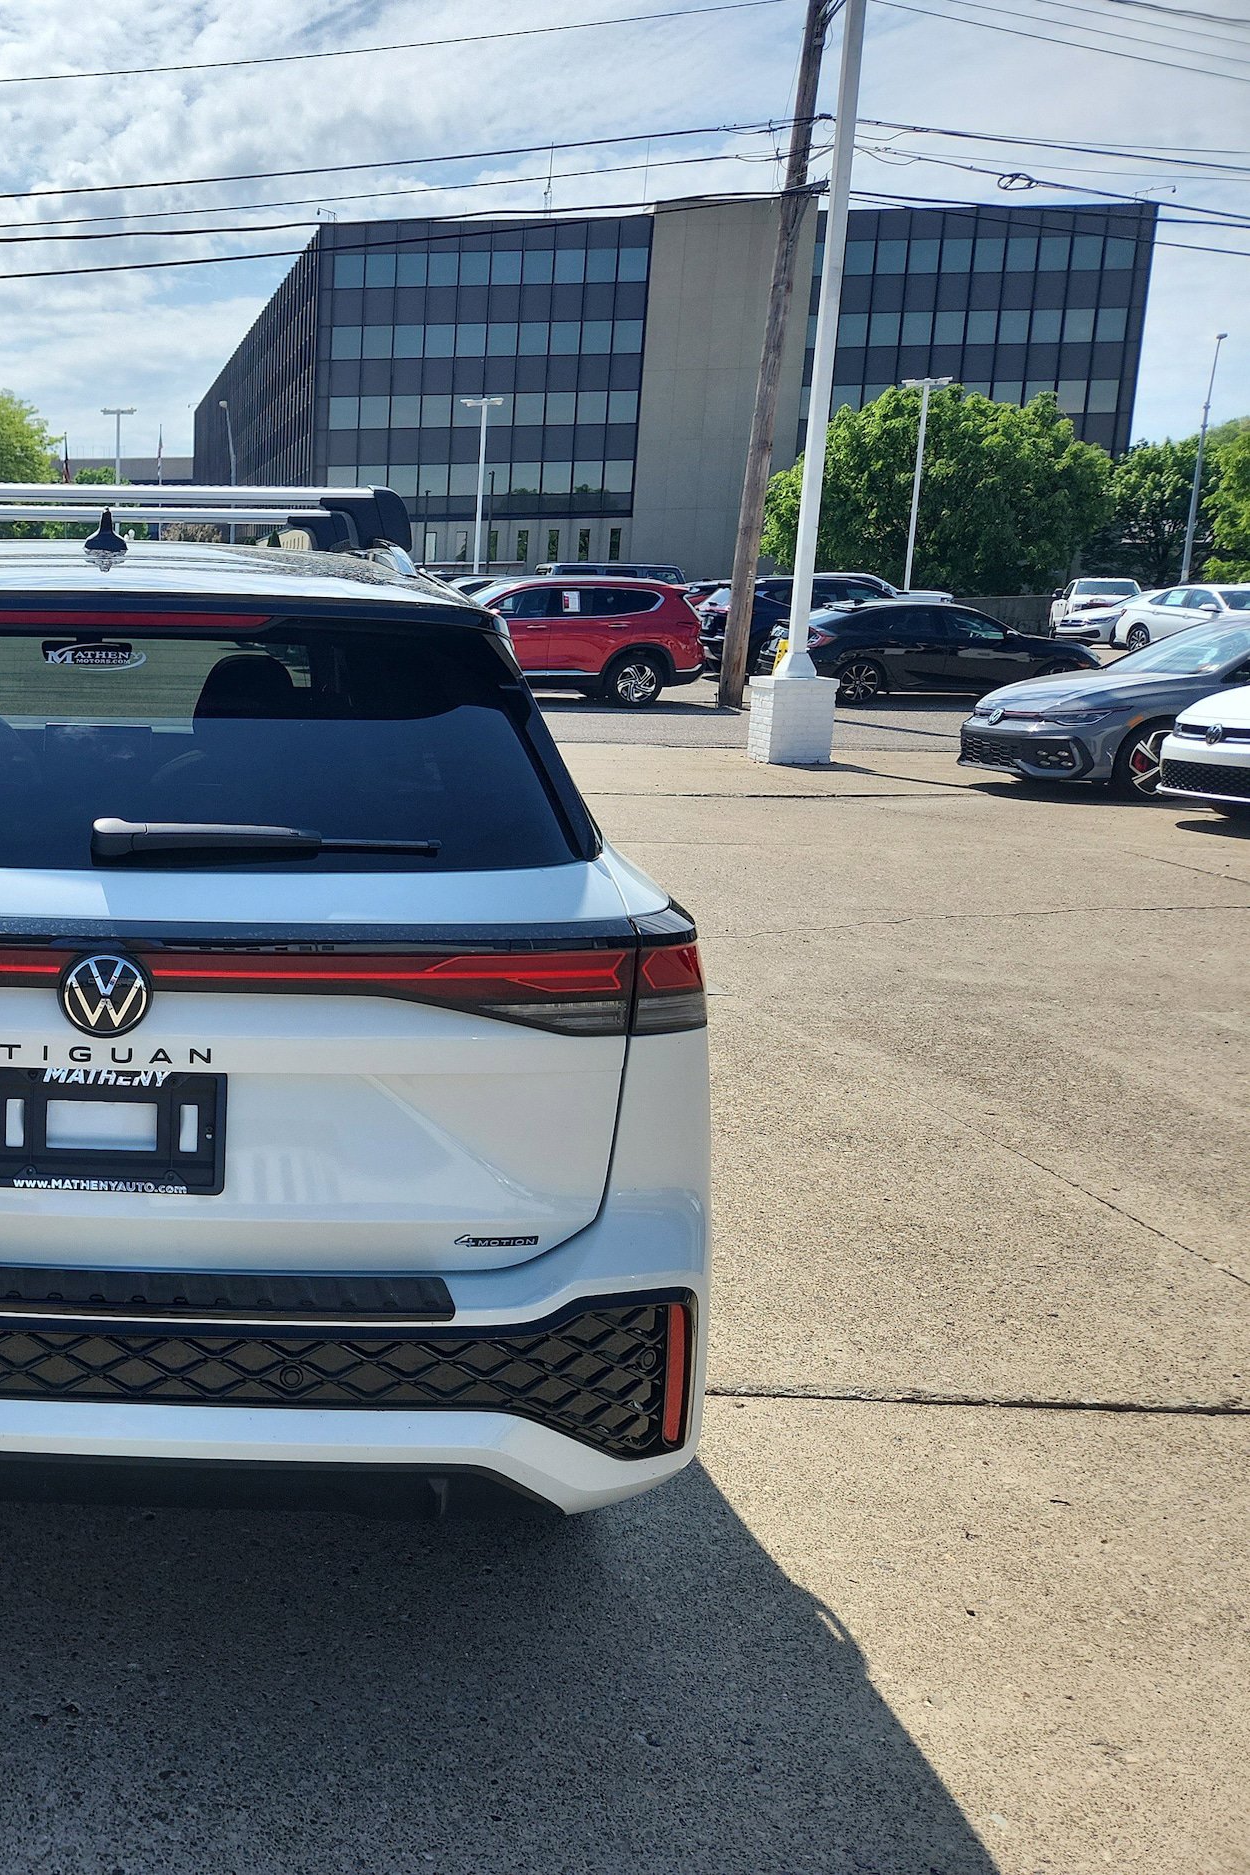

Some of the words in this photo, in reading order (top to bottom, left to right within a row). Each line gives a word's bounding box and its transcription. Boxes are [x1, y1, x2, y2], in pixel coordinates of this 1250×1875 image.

[45, 650, 141, 665] MATHENY
[0, 1043, 212, 1065] TIGUAN
[42, 1067, 171, 1088] MATHENY
[12, 1178, 188, 1194] www.MATHENYAUTO.com
[454, 1234, 536, 1248] 4MOTION
